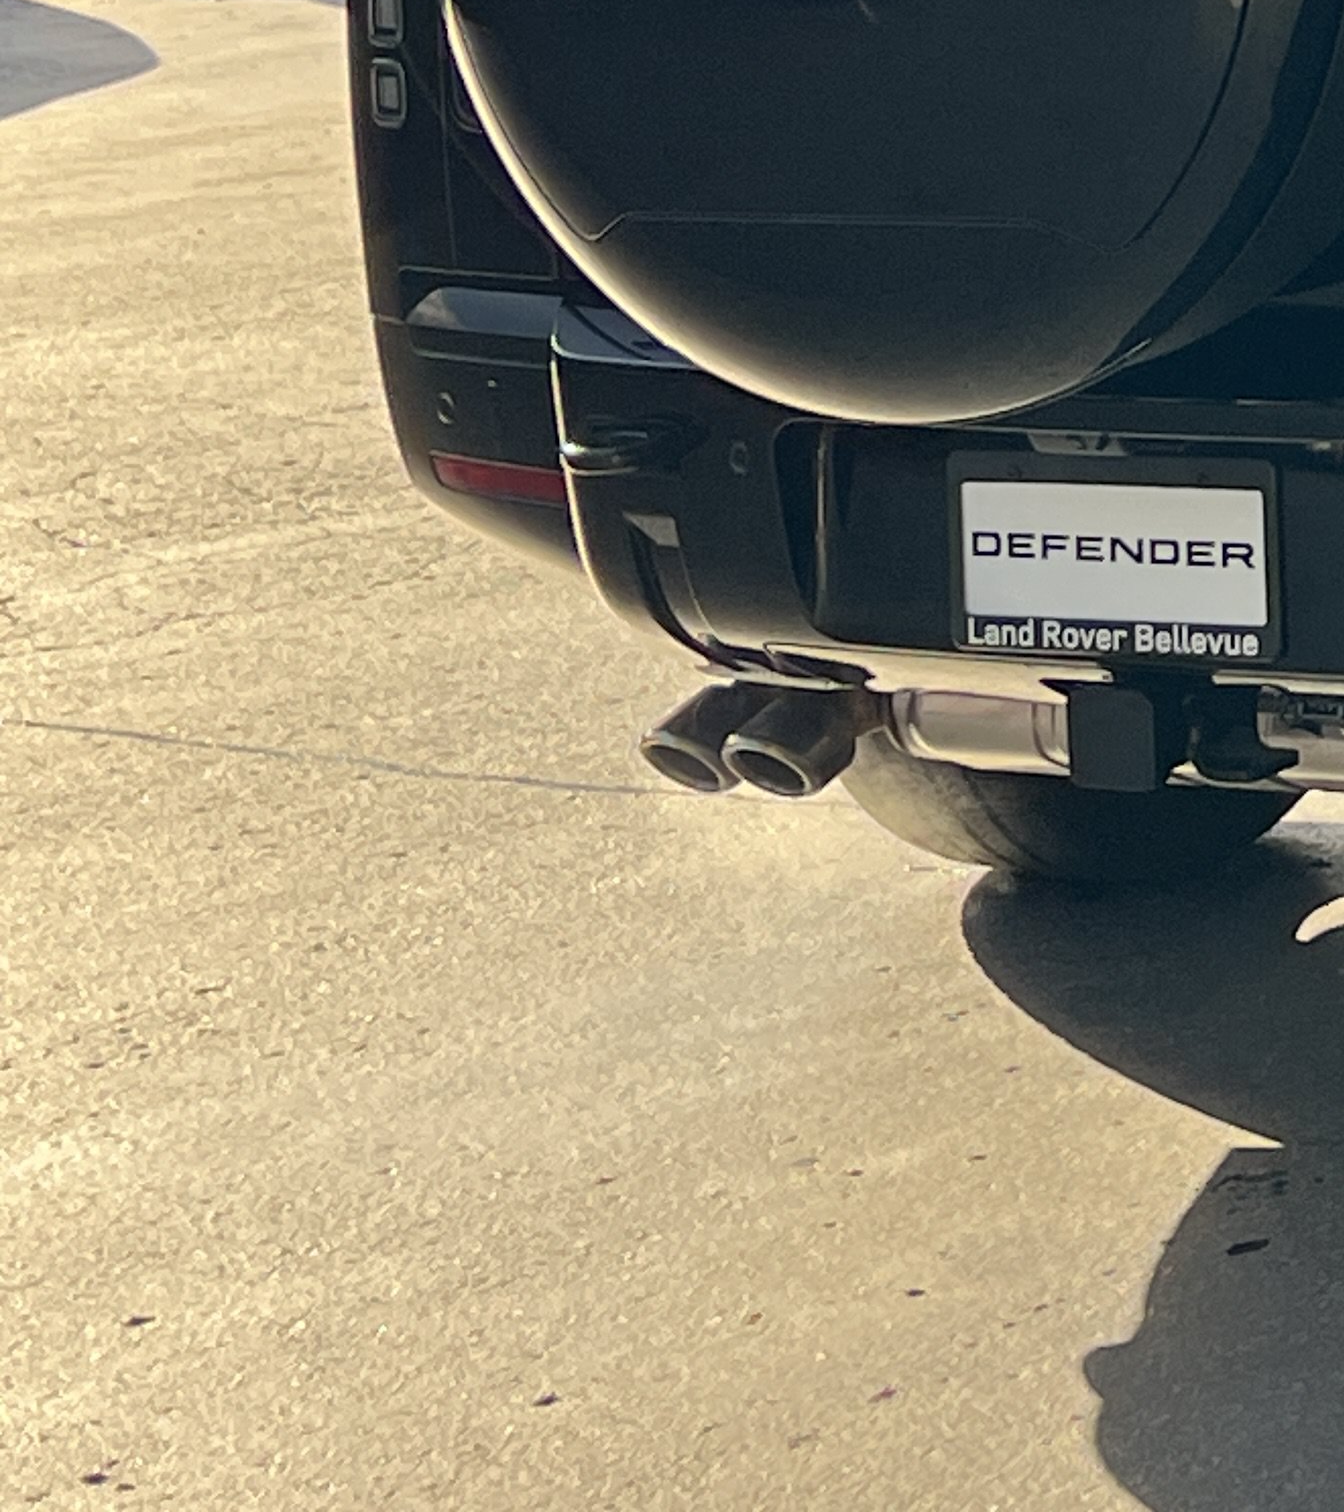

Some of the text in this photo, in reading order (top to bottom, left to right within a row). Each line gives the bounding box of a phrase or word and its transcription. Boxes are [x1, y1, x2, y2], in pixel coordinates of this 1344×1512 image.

[971, 531, 1256, 569] DEFENDER
[967, 617, 1260, 656] Land Rover Bellevue
